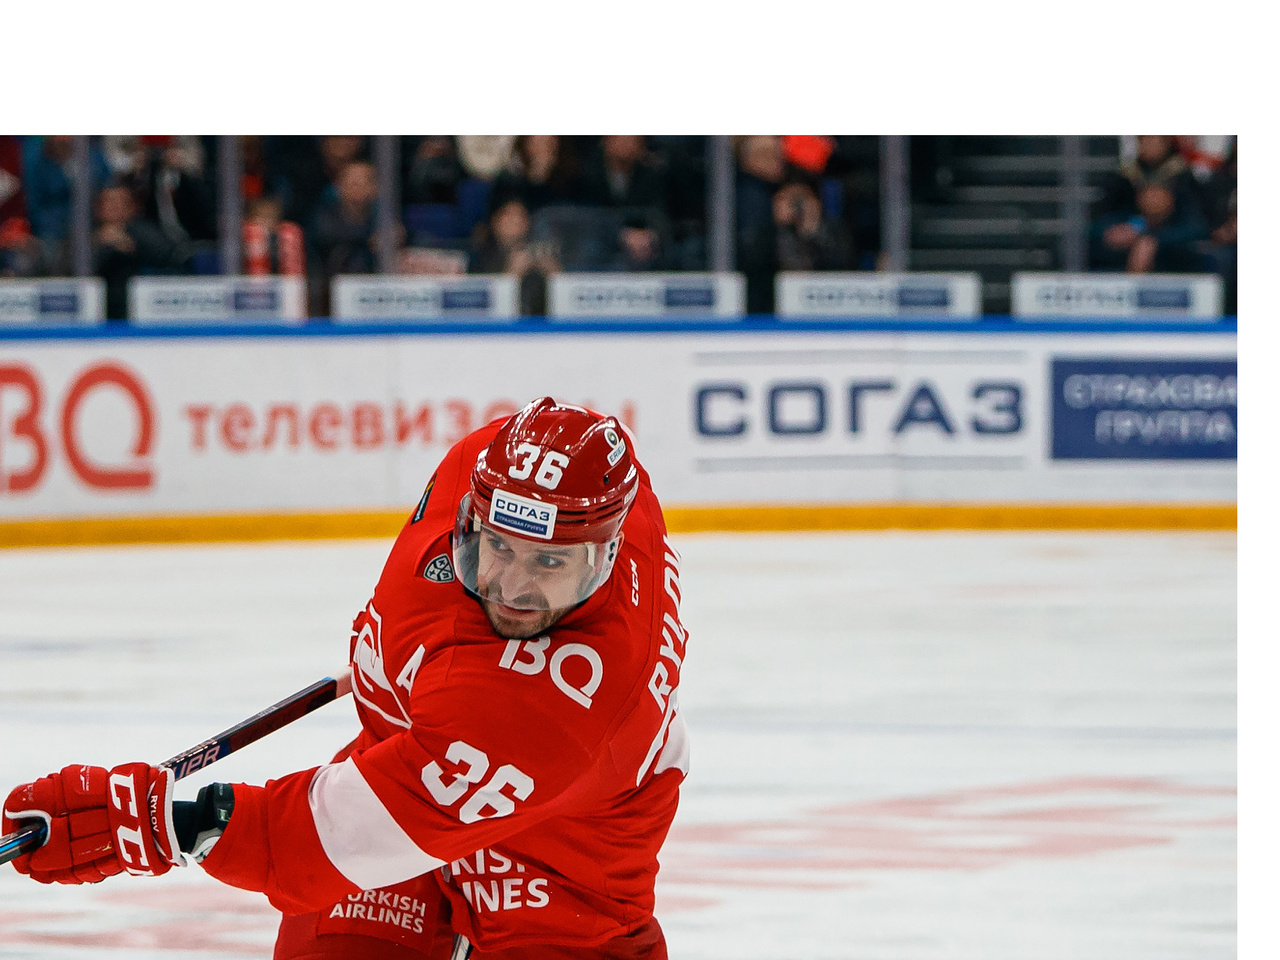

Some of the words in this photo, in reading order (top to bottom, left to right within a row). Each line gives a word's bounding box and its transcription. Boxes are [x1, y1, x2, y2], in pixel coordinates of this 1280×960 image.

[693, 378, 1028, 440] СОГАЗ
[508, 442, 570, 490] 36
[495, 498, 551, 522] СОГАЗ
[499, 636, 604, 709] BQ
[421, 741, 535, 825] 36
[150, 794, 160, 833] RYLOV
[329, 902, 425, 934] AIRLINES
[346, 889, 426, 917] URKISH
